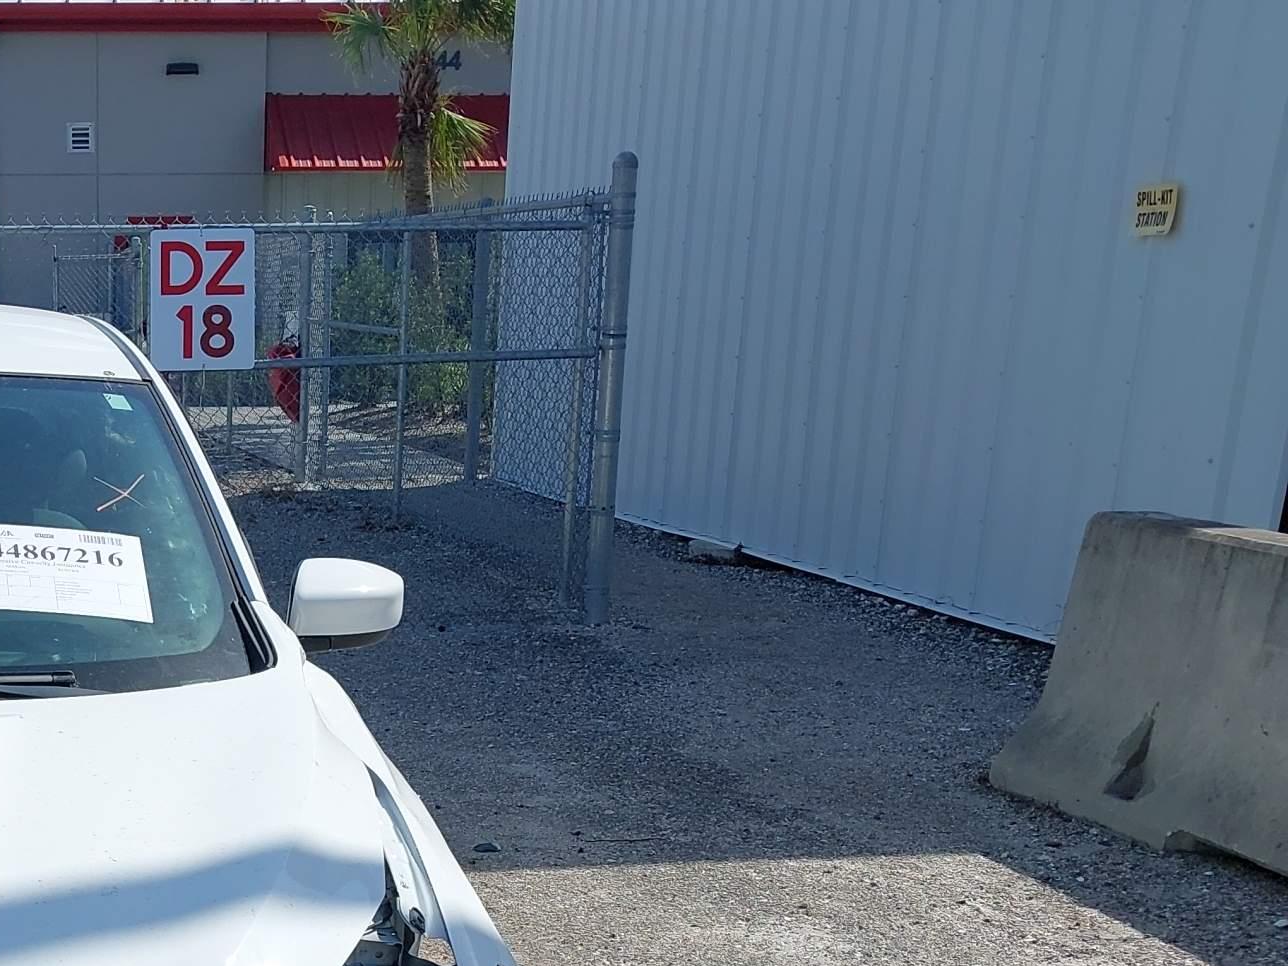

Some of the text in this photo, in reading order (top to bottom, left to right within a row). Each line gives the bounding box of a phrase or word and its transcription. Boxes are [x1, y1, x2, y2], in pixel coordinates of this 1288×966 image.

[1136, 189, 1173, 207] SPILL-KIT
[1135, 211, 1168, 228] STATION
[161, 241, 246, 296] DZ
[176, 304, 235, 359] 18
